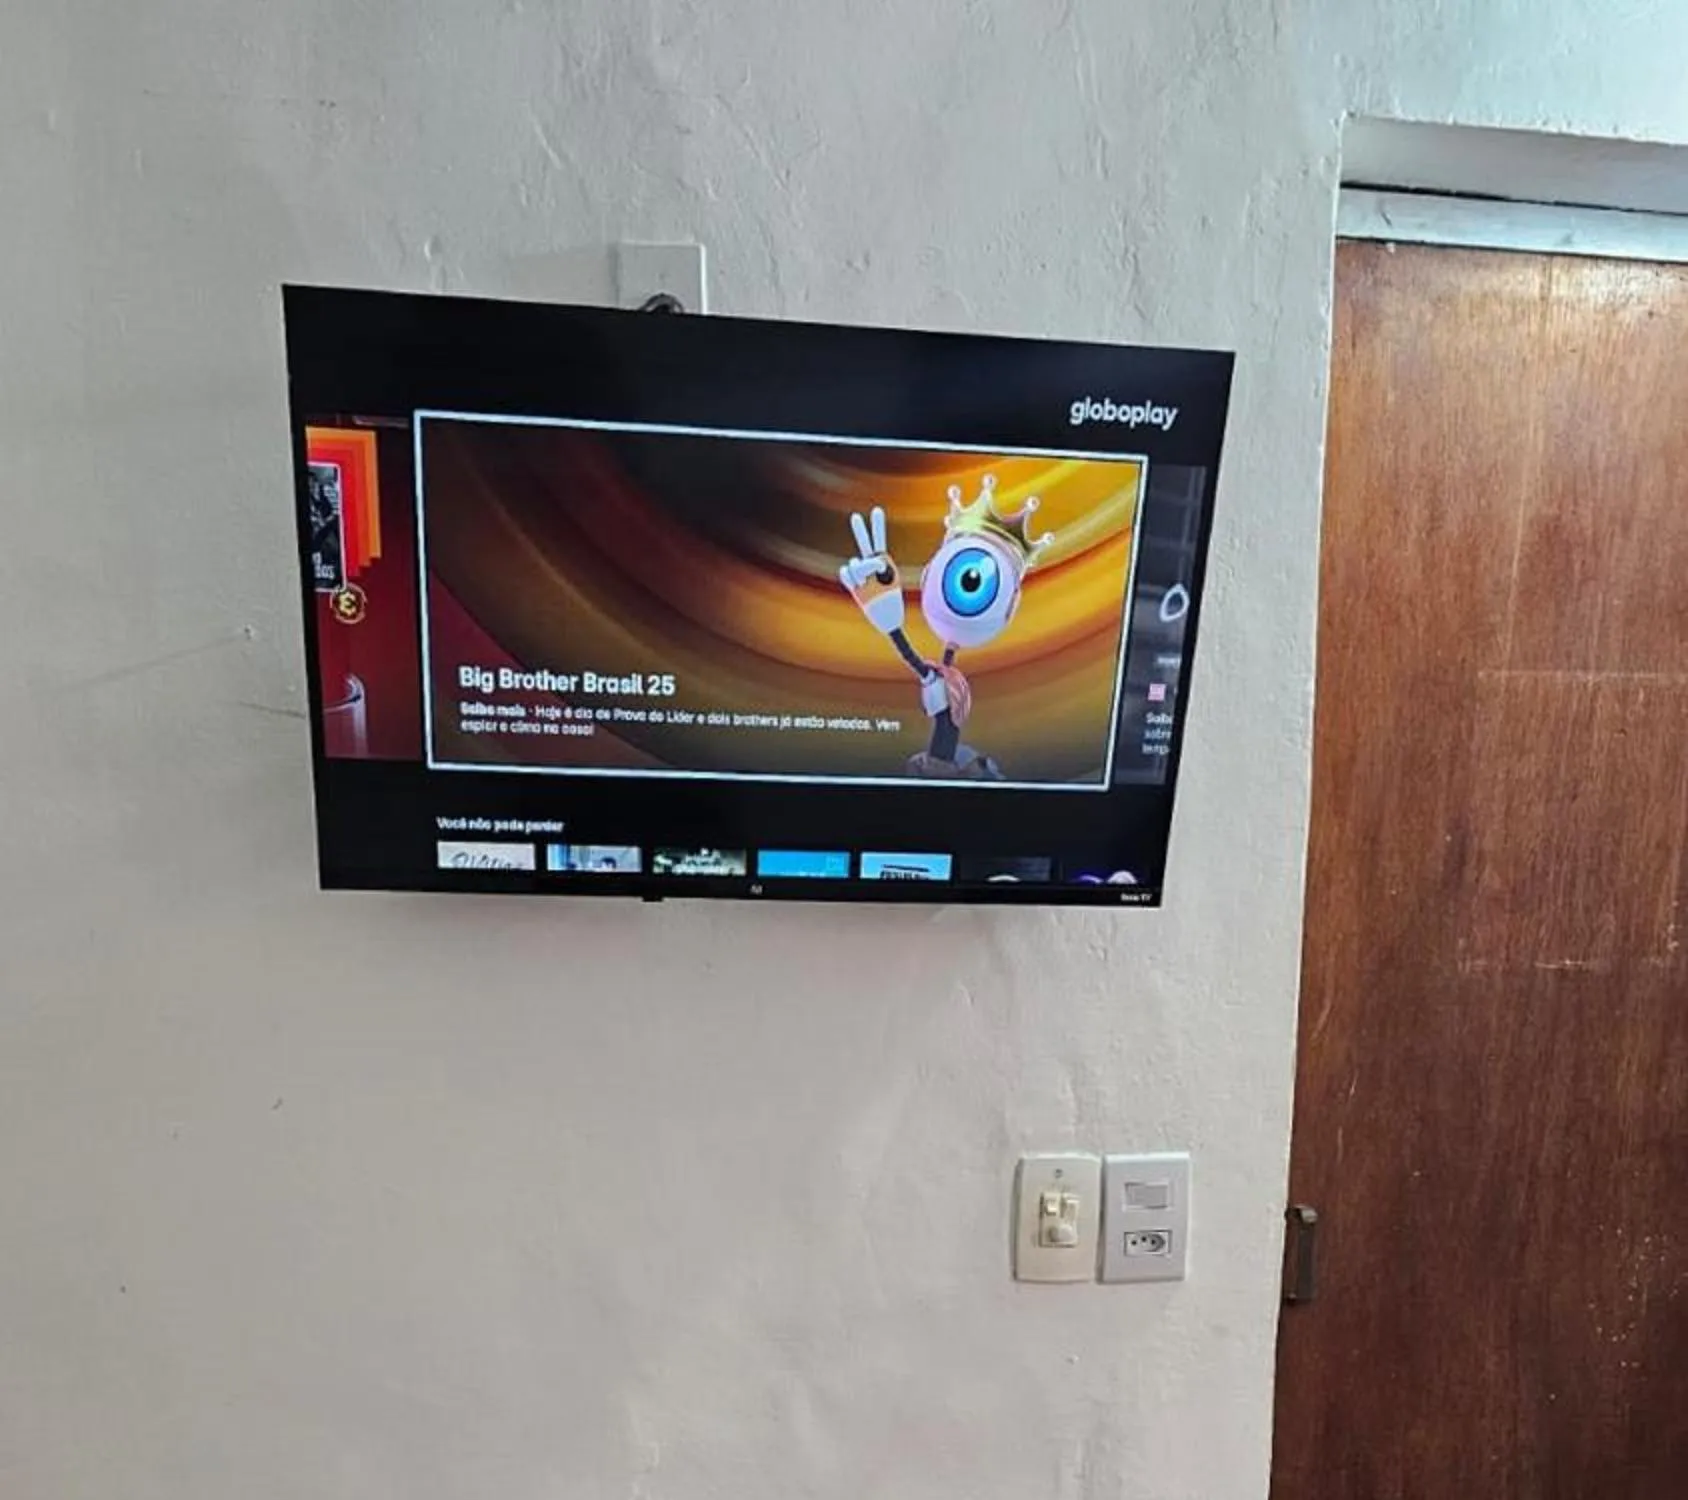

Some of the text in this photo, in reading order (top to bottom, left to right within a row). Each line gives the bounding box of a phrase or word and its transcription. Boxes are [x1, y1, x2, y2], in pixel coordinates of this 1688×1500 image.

[1070, 396, 1178, 431] globoplay
[459, 666, 676, 696] Big Brother Brasil 25
[613, 708, 647, 722] Prova
[733, 713, 778, 728] brothers
[436, 816, 564, 834] Você não pode perder
